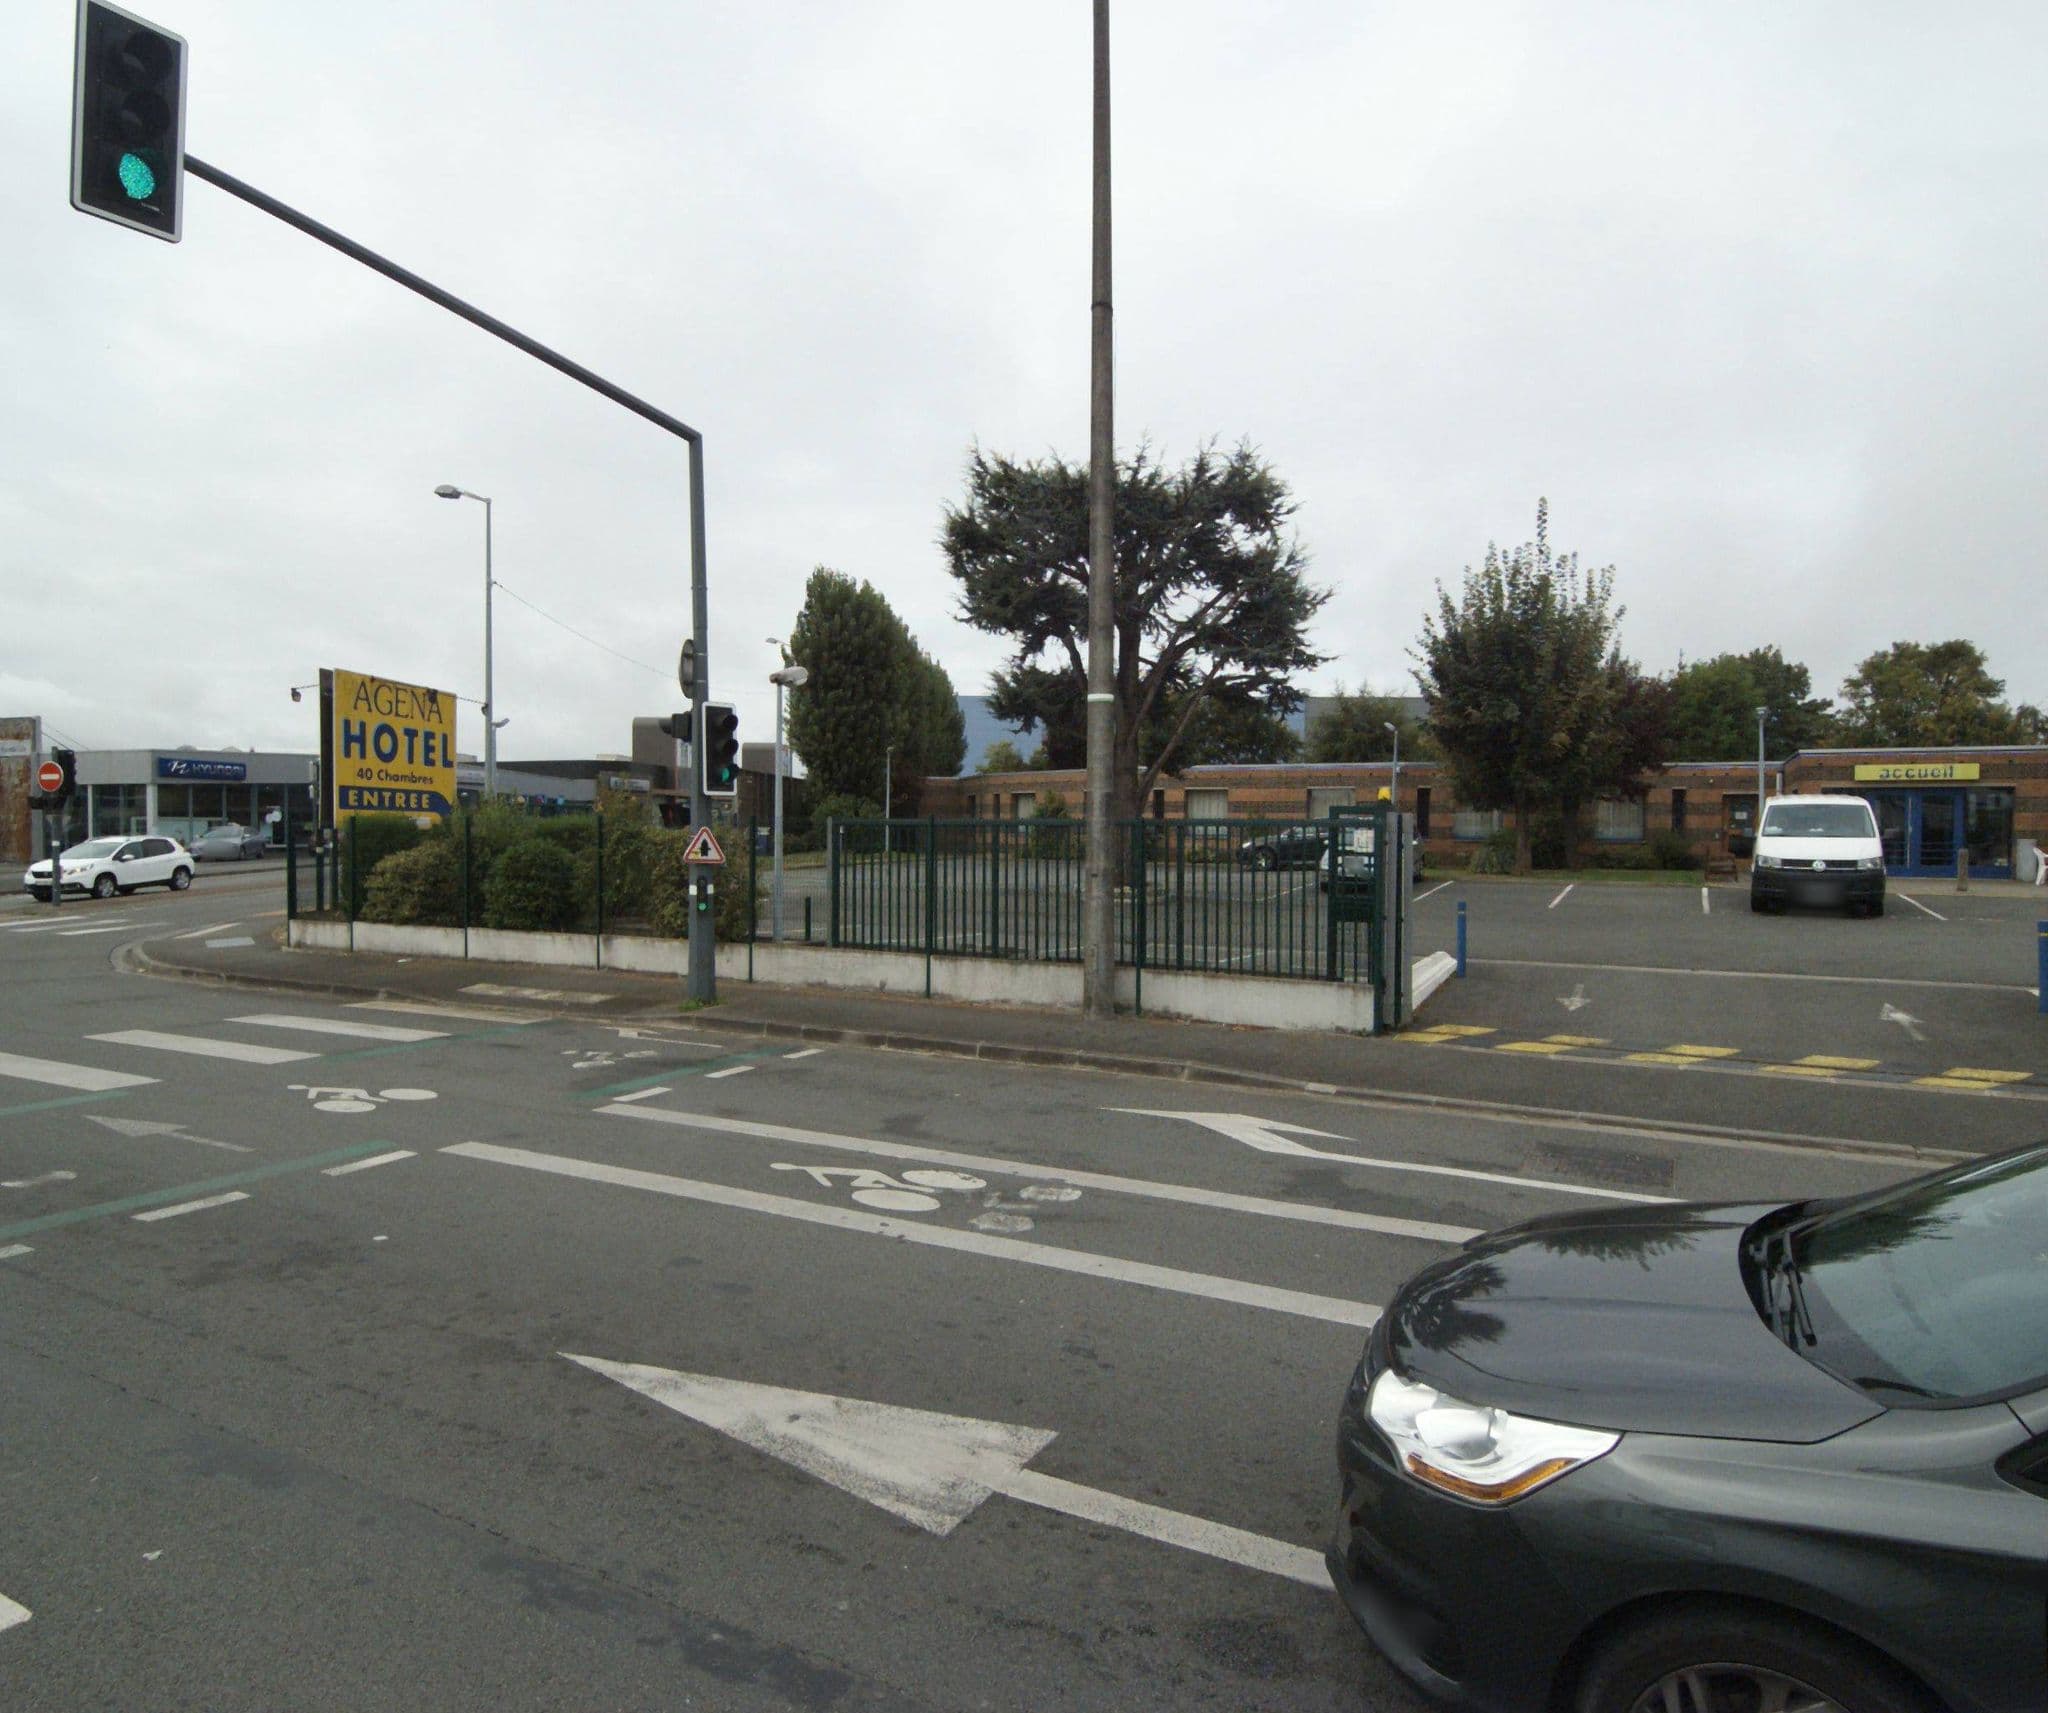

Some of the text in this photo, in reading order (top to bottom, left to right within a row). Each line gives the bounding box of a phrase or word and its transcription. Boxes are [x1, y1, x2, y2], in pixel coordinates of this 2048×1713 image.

[353, 680, 443, 724] AGENA
[343, 719, 454, 769] HOTEL
[356, 767, 434, 785] 40 Chambres
[1880, 765, 1954, 779] accueil
